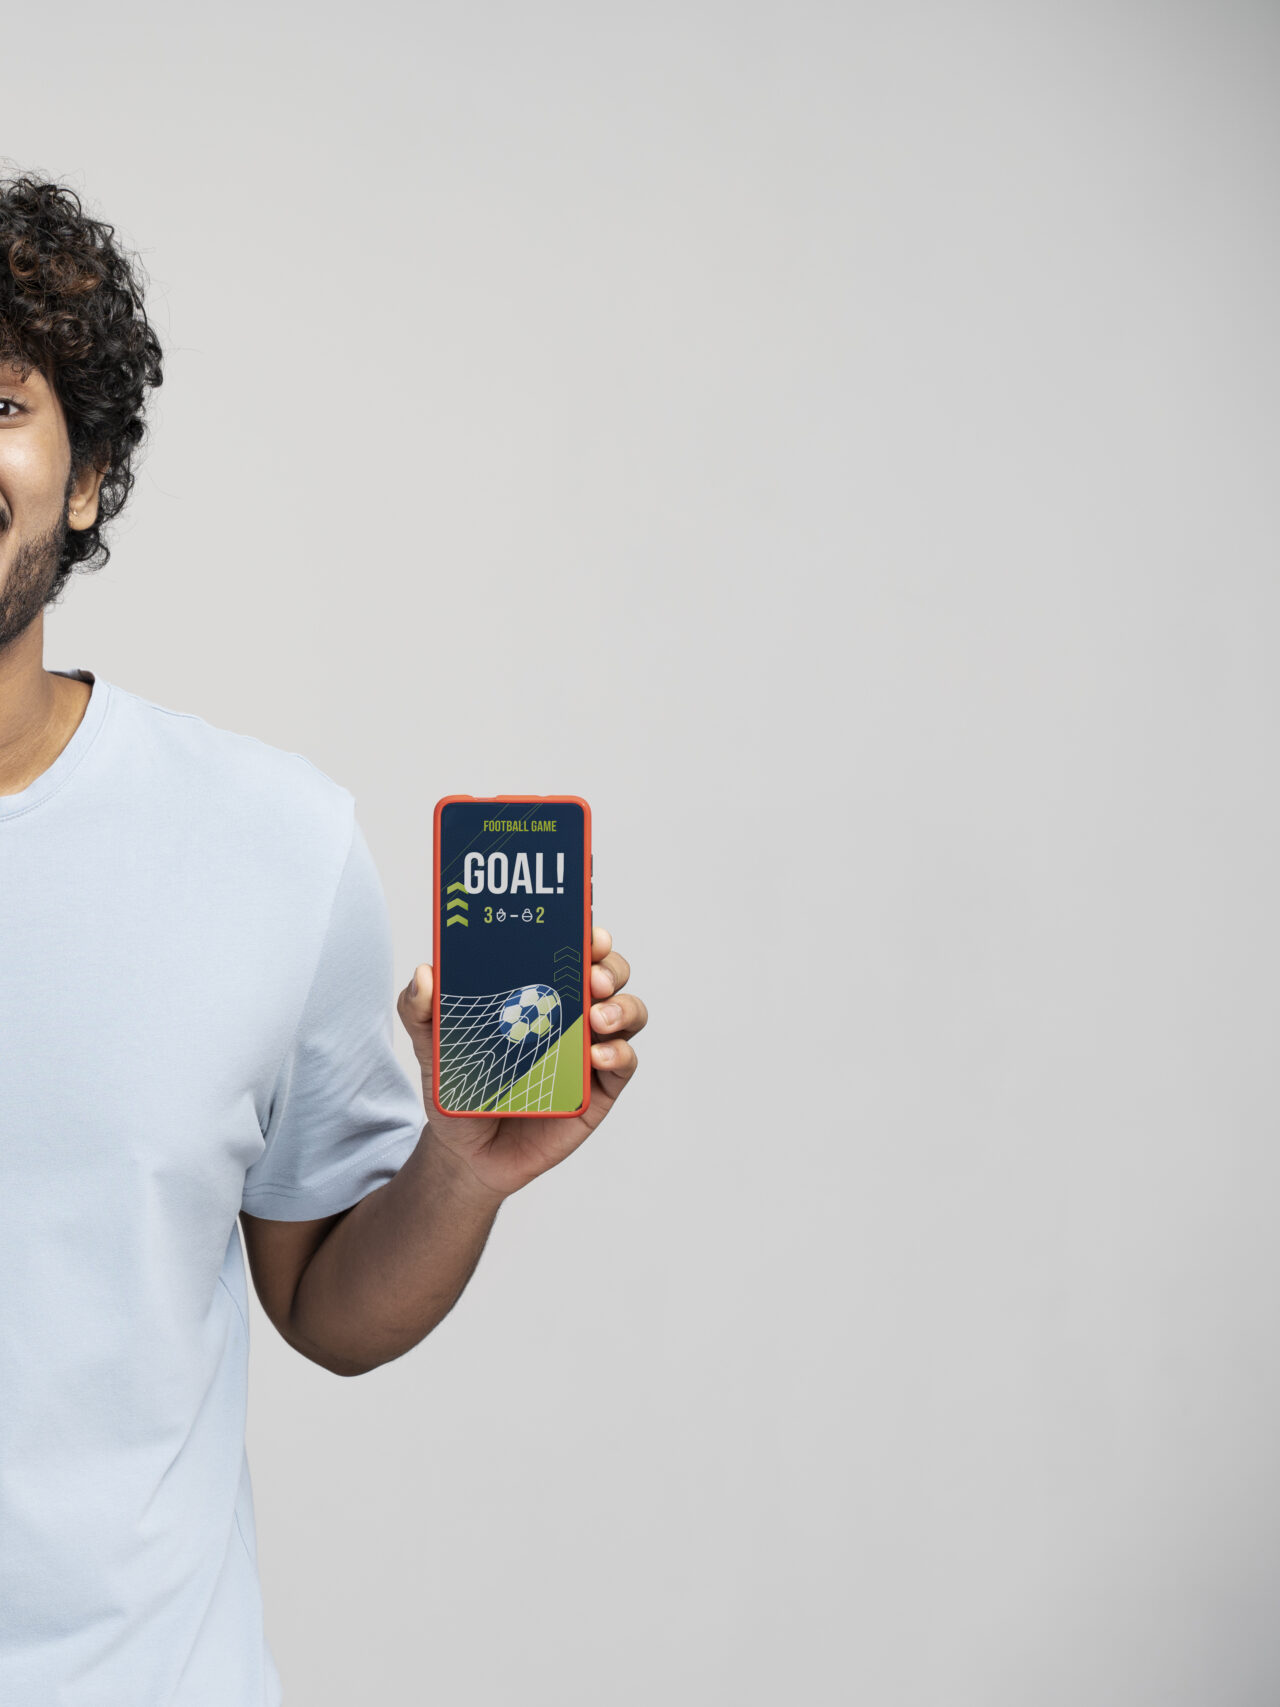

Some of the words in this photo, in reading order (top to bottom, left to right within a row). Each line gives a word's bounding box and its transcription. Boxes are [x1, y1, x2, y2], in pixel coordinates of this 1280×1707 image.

[483, 820, 529, 832] FOOTBALL
[531, 820, 557, 832] GAME
[463, 851, 565, 895] GOAL!
[483, 906, 493, 924] 3
[535, 906, 545, 924] 2
